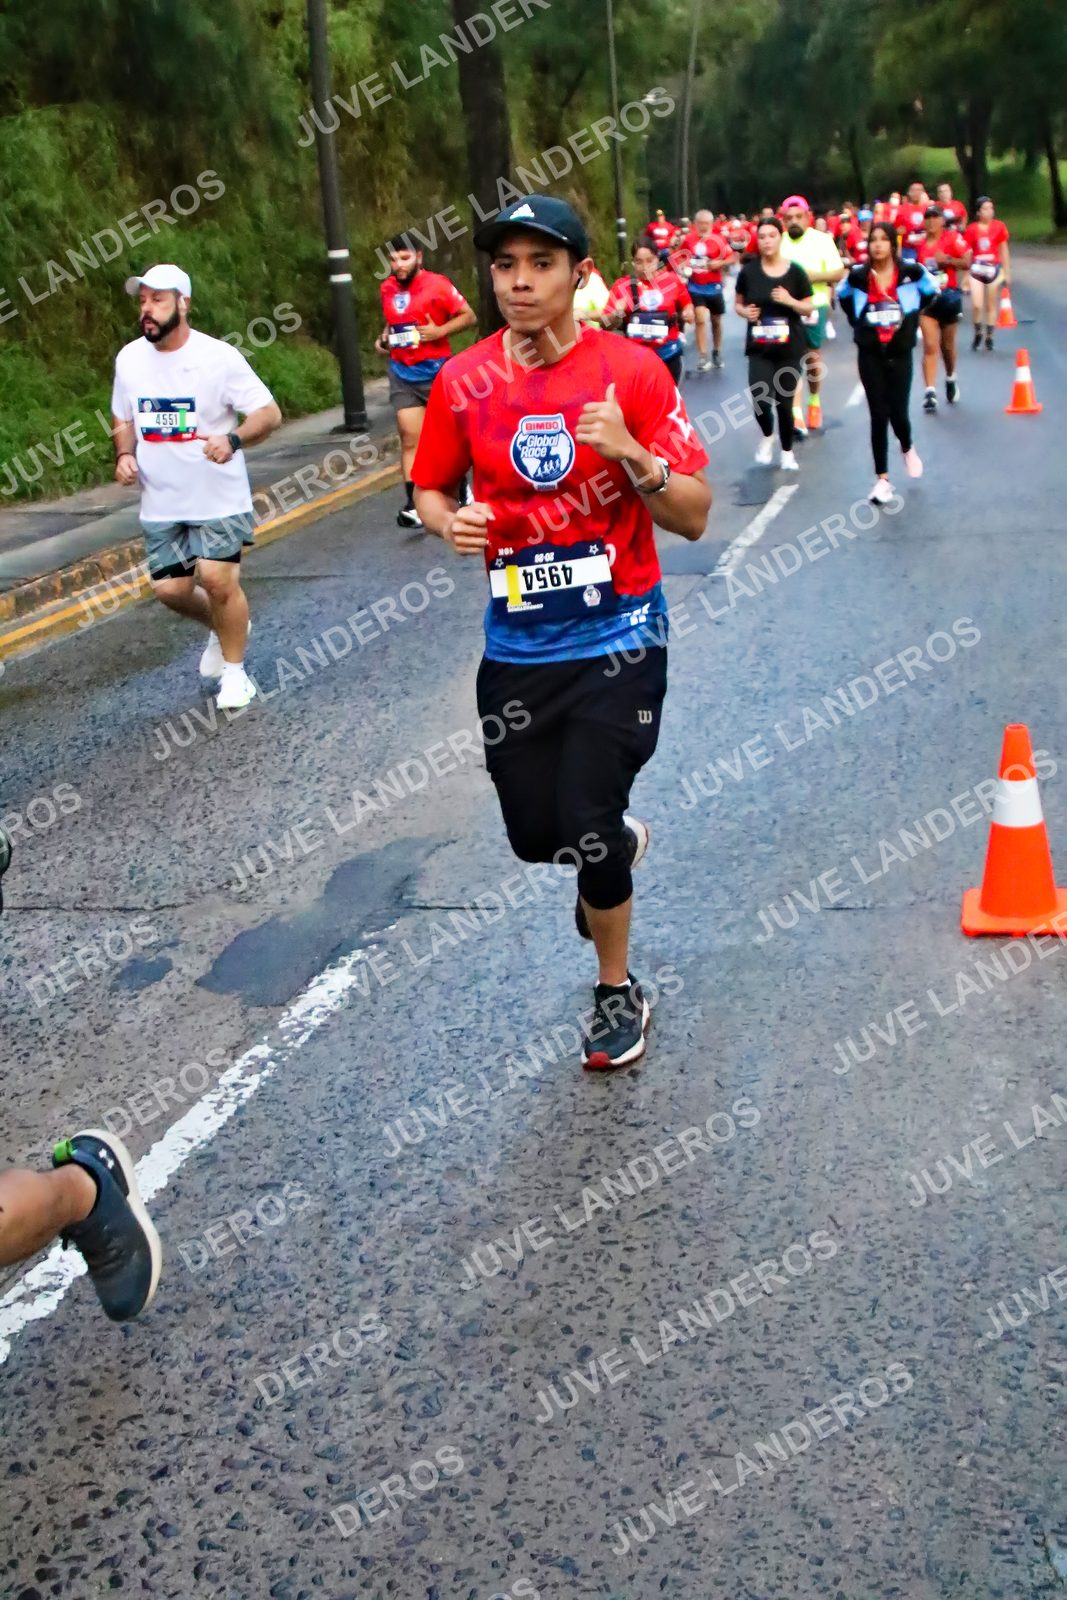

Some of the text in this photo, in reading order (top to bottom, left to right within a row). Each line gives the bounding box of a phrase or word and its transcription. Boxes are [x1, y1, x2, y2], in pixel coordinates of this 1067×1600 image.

[155, 413, 178, 426] 4551
[525, 421, 559, 431] BIMBO
[526, 434, 559, 447] Global
[521, 446, 547, 458] Race
[522, 564, 573, 591] 4954
